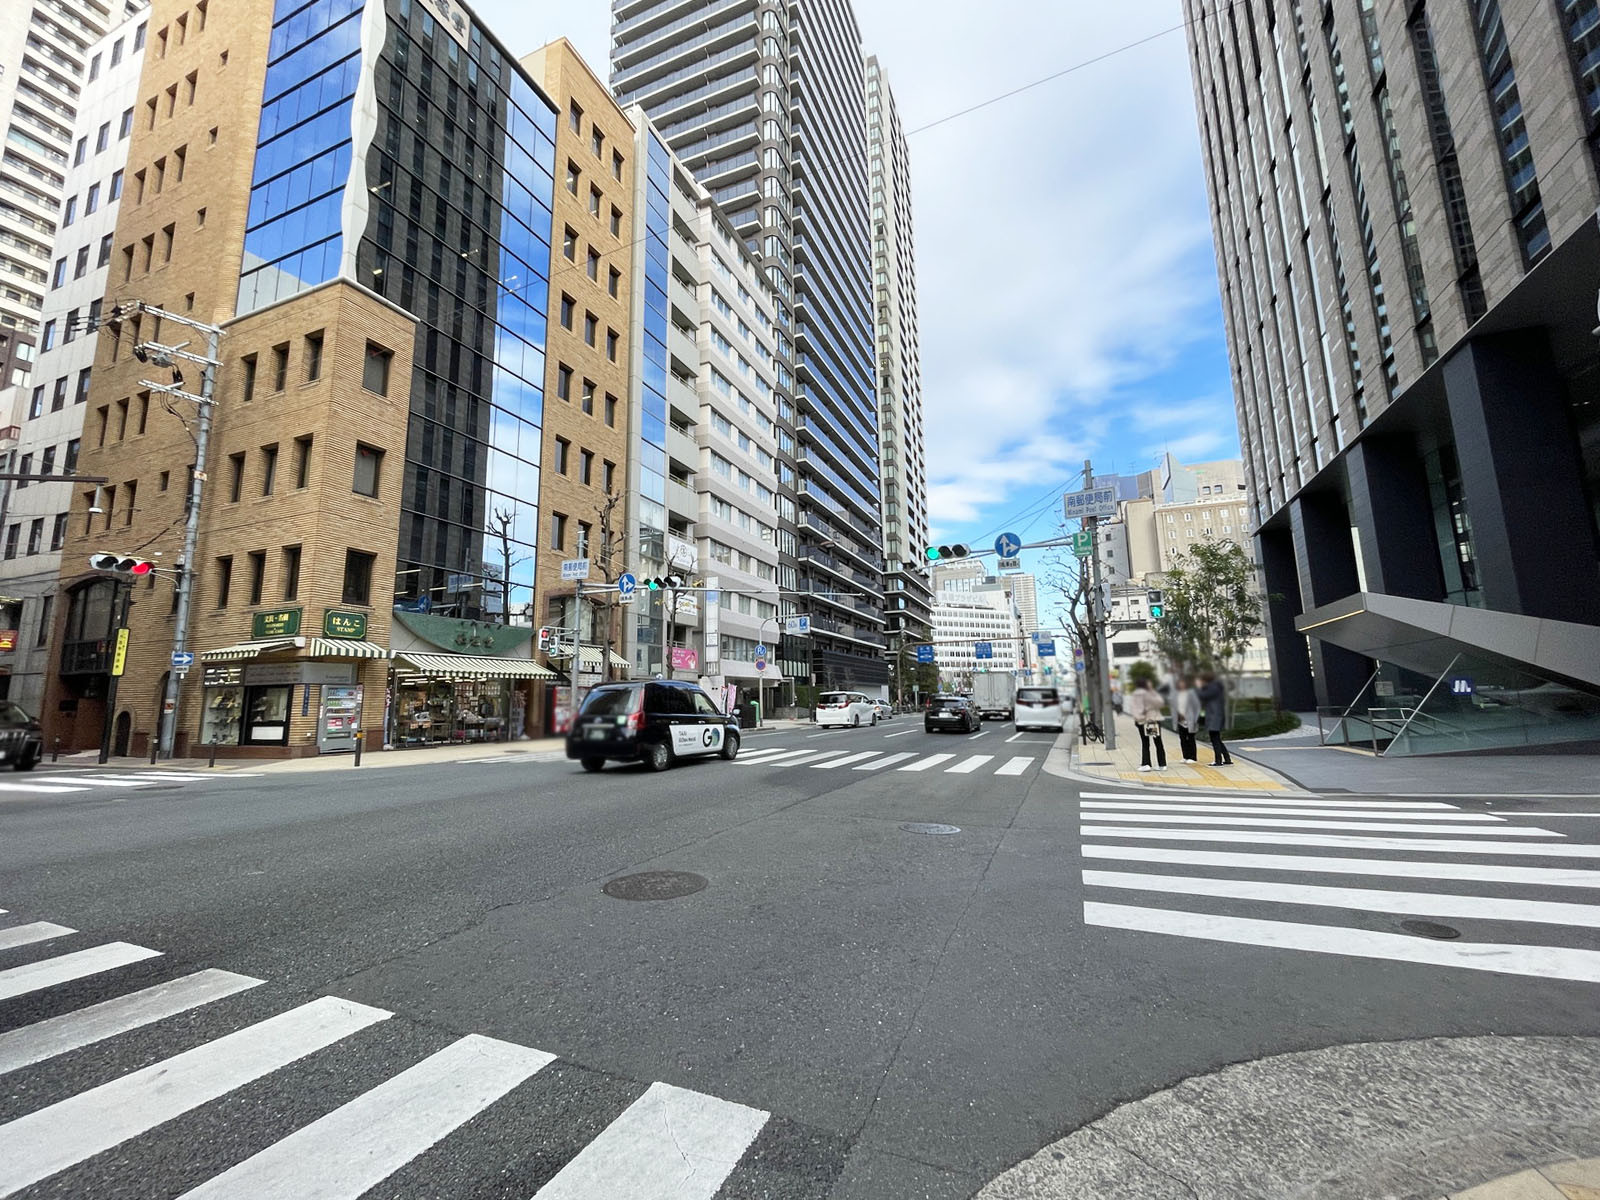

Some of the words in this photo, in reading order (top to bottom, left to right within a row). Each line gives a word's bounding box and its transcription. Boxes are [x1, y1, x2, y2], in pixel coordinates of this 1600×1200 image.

[1067, 491, 1113, 508] 南郵便局前
[332, 617, 360, 627] はんこ
